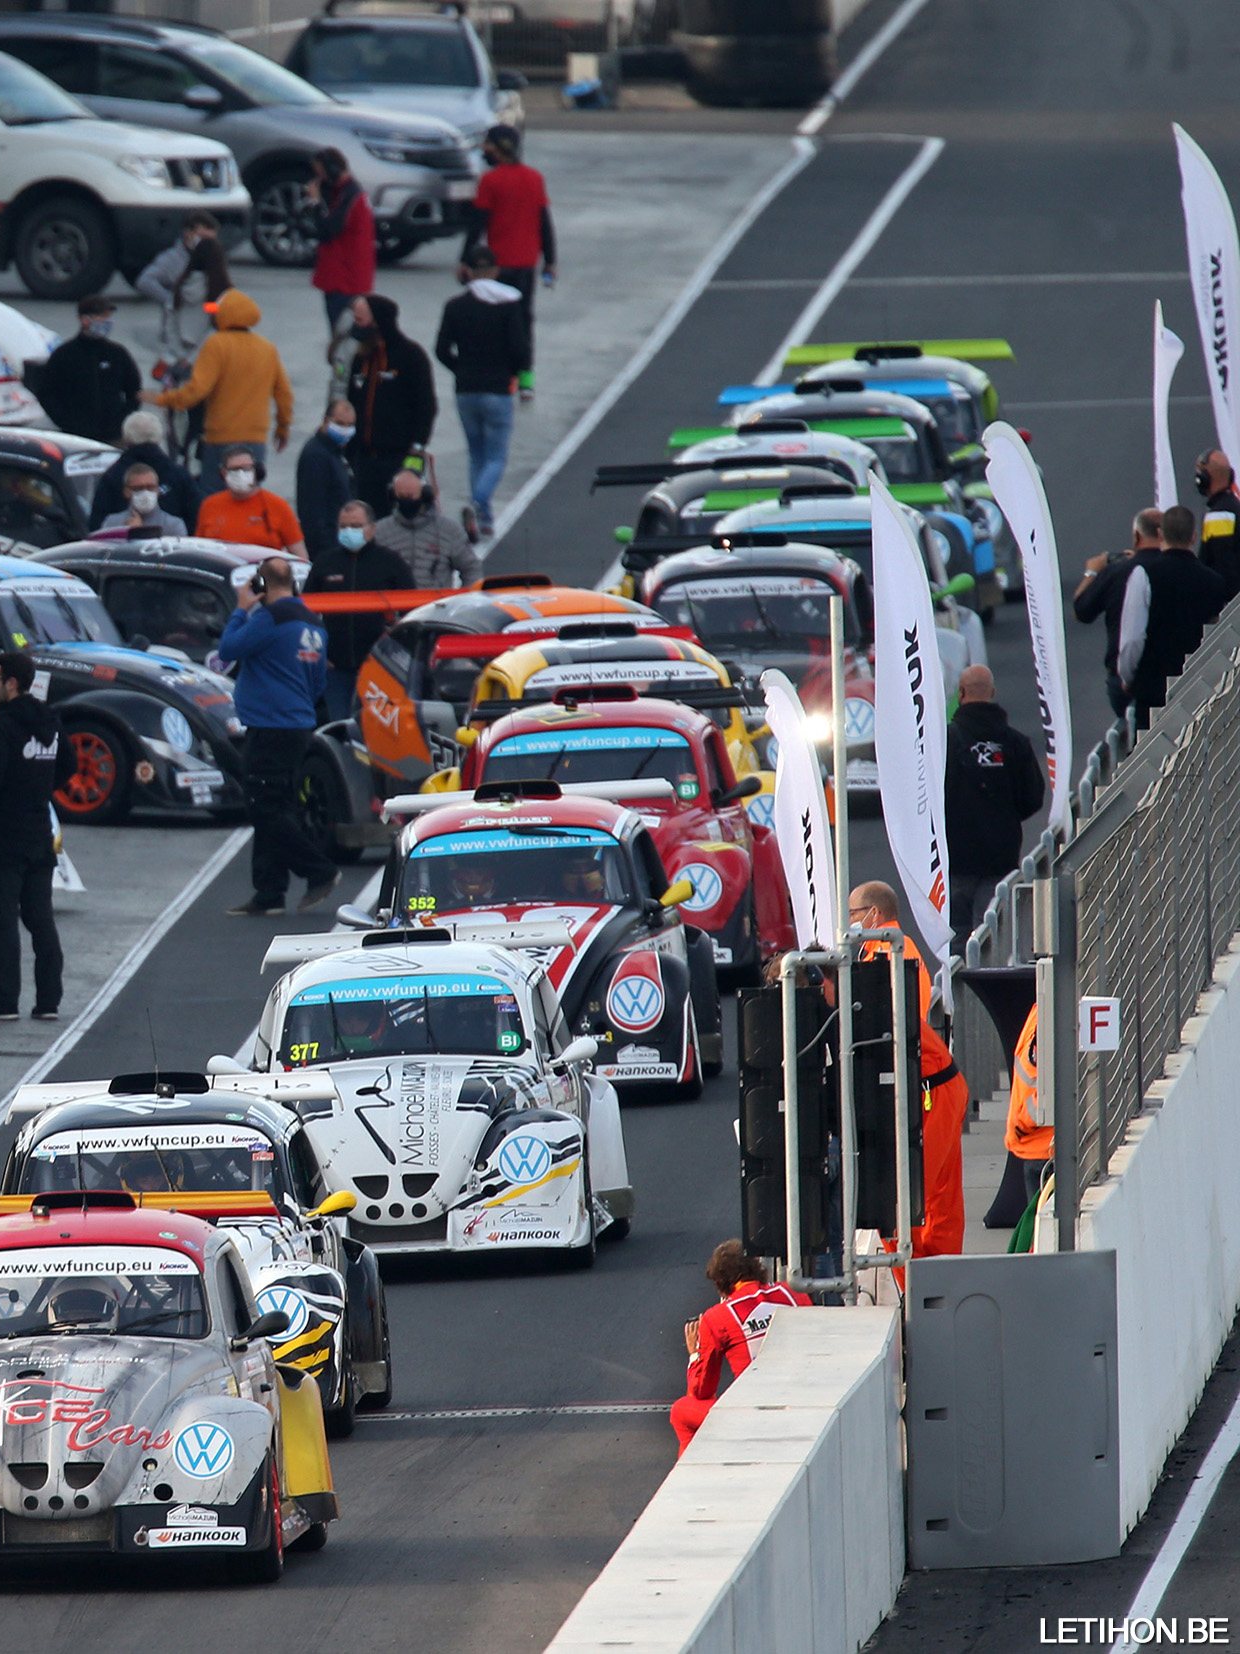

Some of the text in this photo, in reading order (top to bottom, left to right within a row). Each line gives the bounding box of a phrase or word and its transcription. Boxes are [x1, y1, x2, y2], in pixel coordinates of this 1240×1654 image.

[560, 668, 680, 682] www.vwfuncup.eu
[526, 736, 651, 751] www.vwfuncup.eu
[681, 784, 696, 795] BI
[450, 834, 581, 851] www.vwfuncup.eu
[408, 897, 436, 910] 352
[331, 983, 471, 1000] www.vwfuncup.eu
[1090, 1005, 1111, 1044] F
[500, 1035, 517, 1047] BI
[290, 1042, 320, 1062] 377
[76, 1134, 225, 1150] www.vwfuncup.eu
[65, 1408, 174, 1452] Cars
